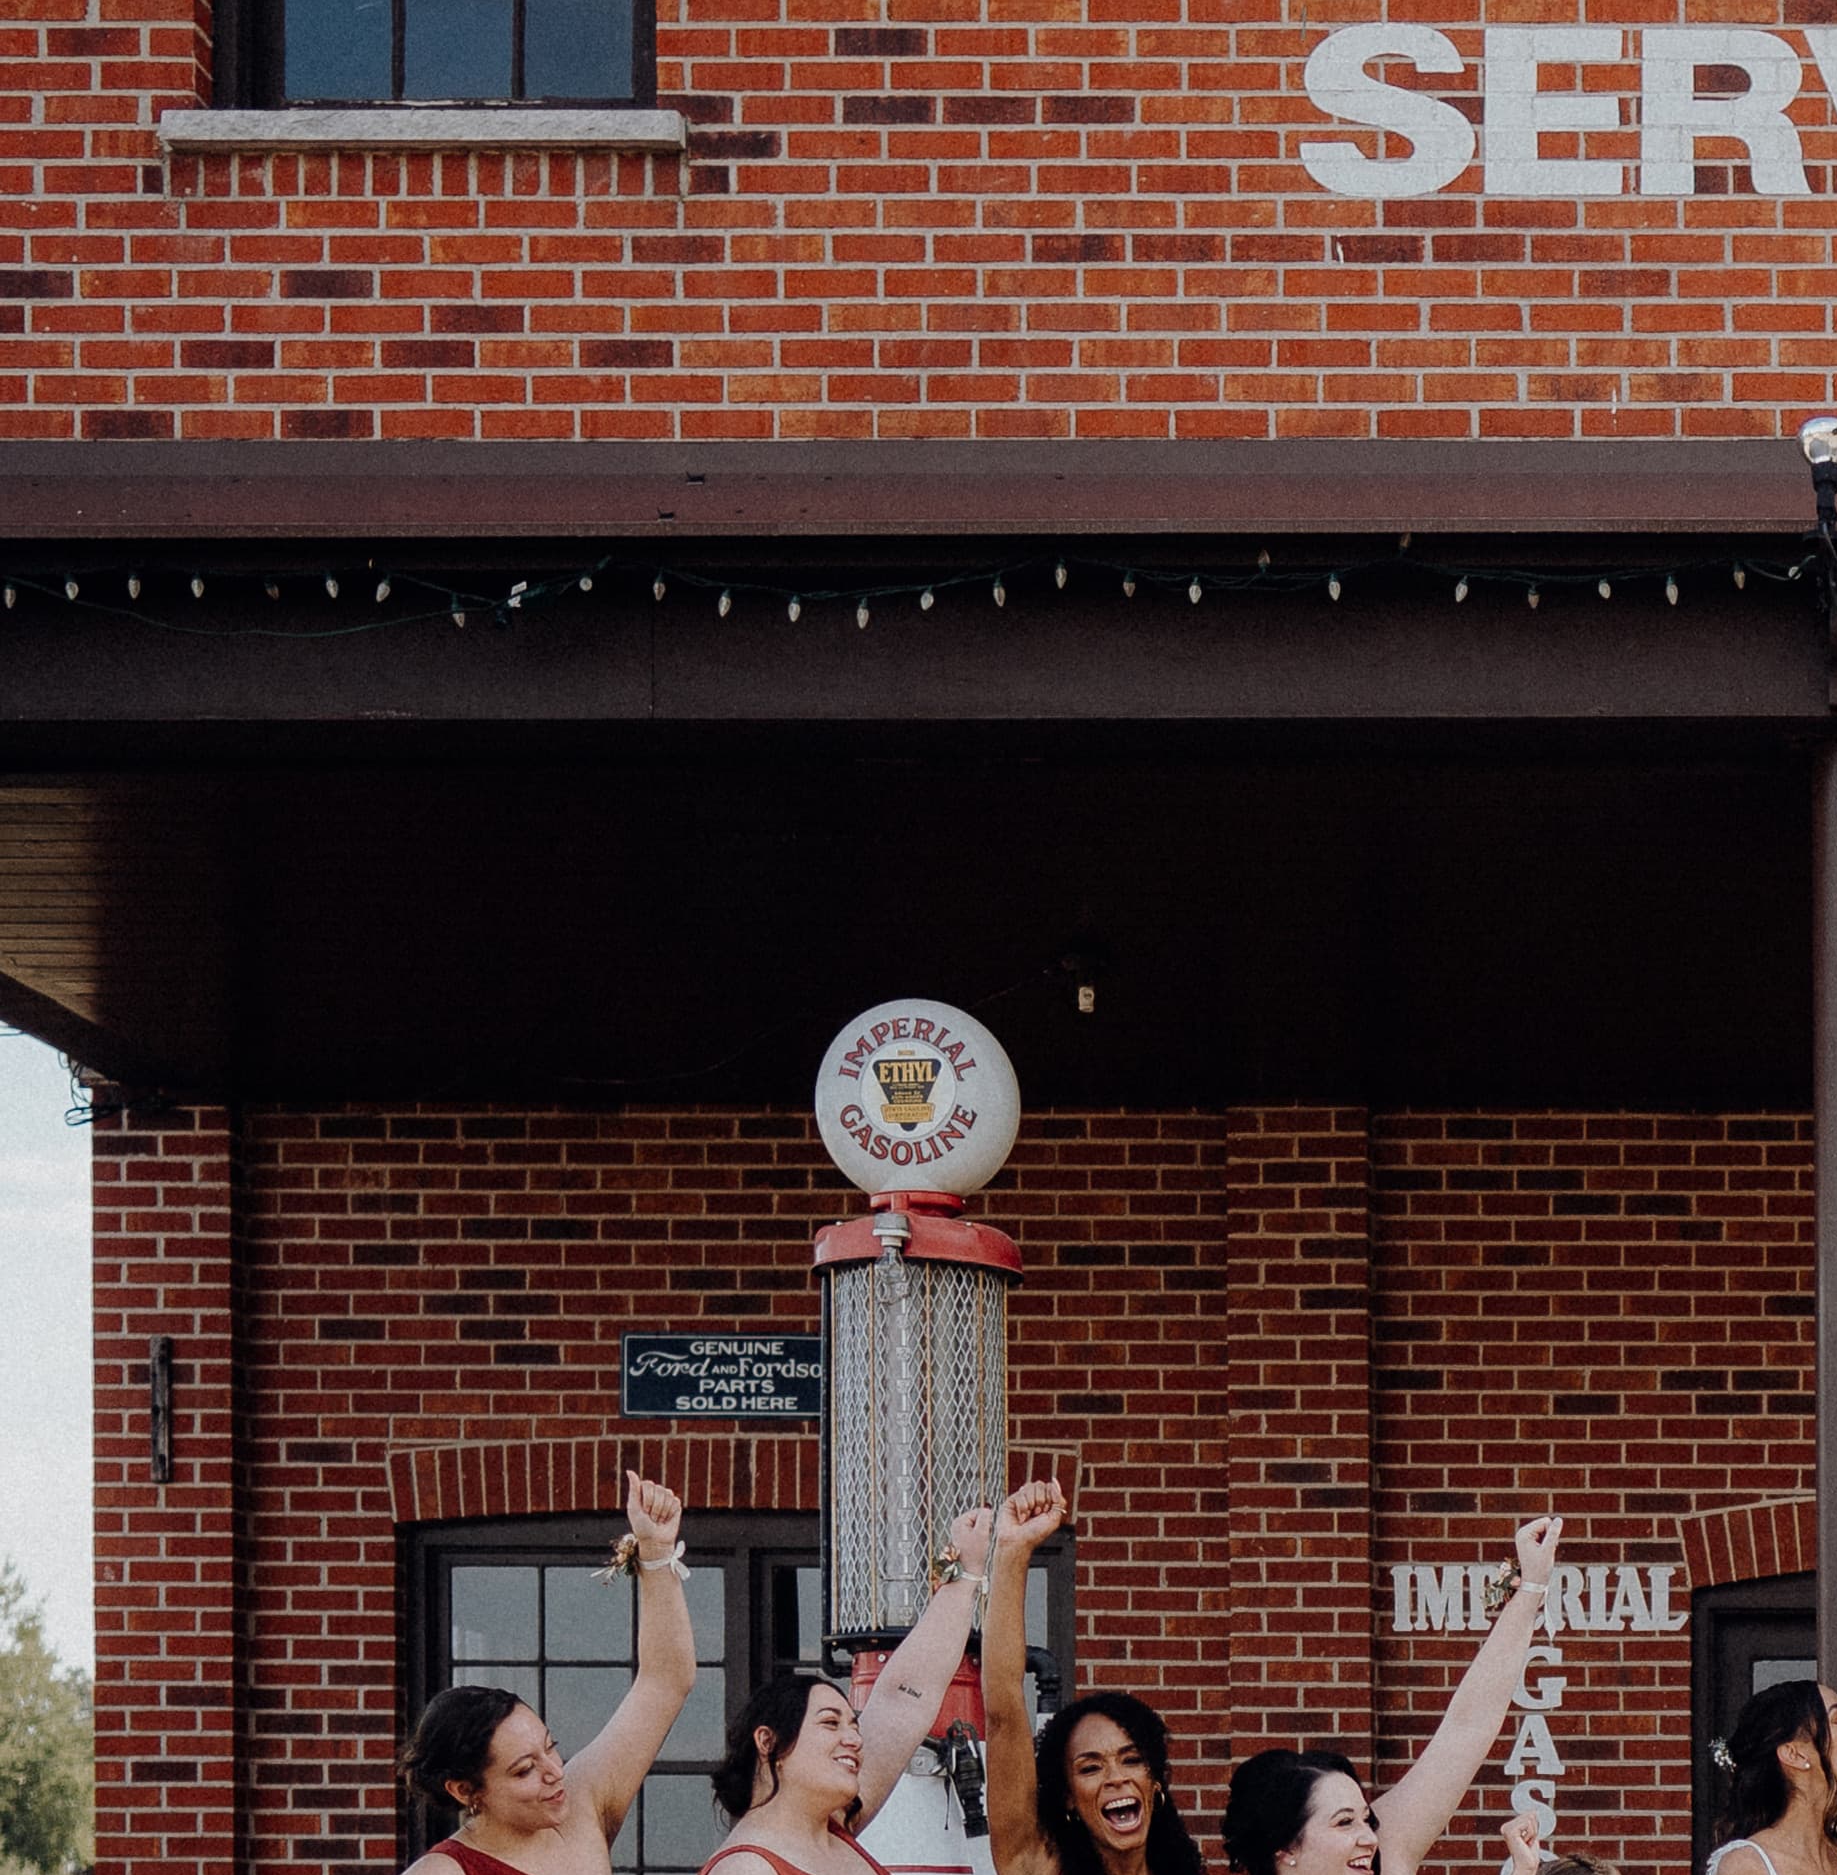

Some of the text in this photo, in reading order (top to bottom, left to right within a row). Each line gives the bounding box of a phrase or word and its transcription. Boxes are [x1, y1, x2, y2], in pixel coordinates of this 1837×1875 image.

[839, 1017, 977, 1082] IMPERIAL
[878, 1061, 937, 1083] ETHYL
[840, 1104, 978, 1166] GASOLINE
[690, 1341, 785, 1355] GENUINE
[629, 1351, 822, 1378] Ford AND Fordso
[699, 1379, 776, 1394] PARTS
[675, 1396, 798, 1411] SOLD HERE
[1390, 1565, 1689, 1631] IMPRIAL
